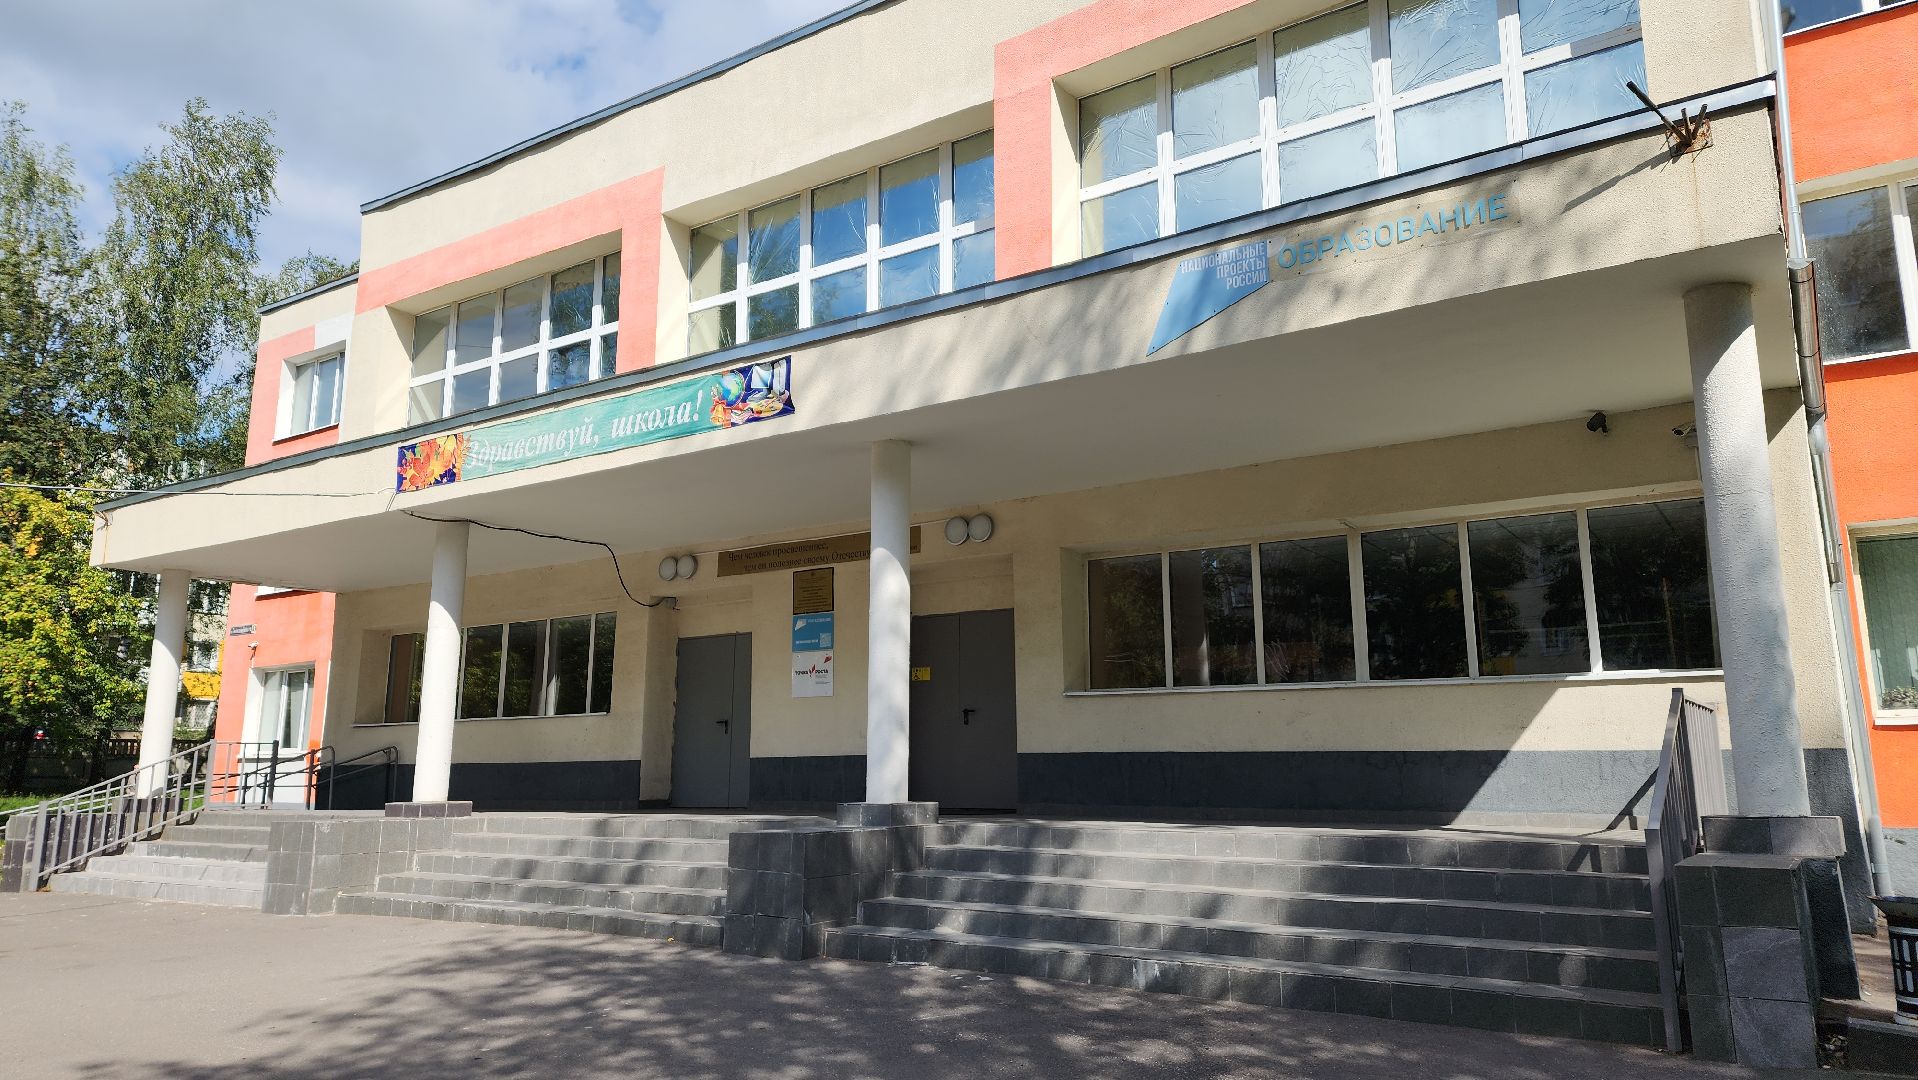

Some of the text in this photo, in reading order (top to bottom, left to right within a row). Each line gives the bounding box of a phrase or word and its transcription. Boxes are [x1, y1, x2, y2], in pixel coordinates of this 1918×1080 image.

[1277, 193, 1508, 269] ОБРАЗОВАНИЕ
[1180, 242, 1265, 274] НАЦИОНАЛЬНЫЕ
[1216, 256, 1266, 279] ПРОЕКТЫ
[1226, 269, 1267, 290] РОССИИ
[465, 389, 703, 473] Здравствуй, школа!
[728, 552, 743, 561] Чем
[744, 550, 771, 560] человек
[768, 559, 802, 569] полезнее
[803, 555, 830, 565] своему
